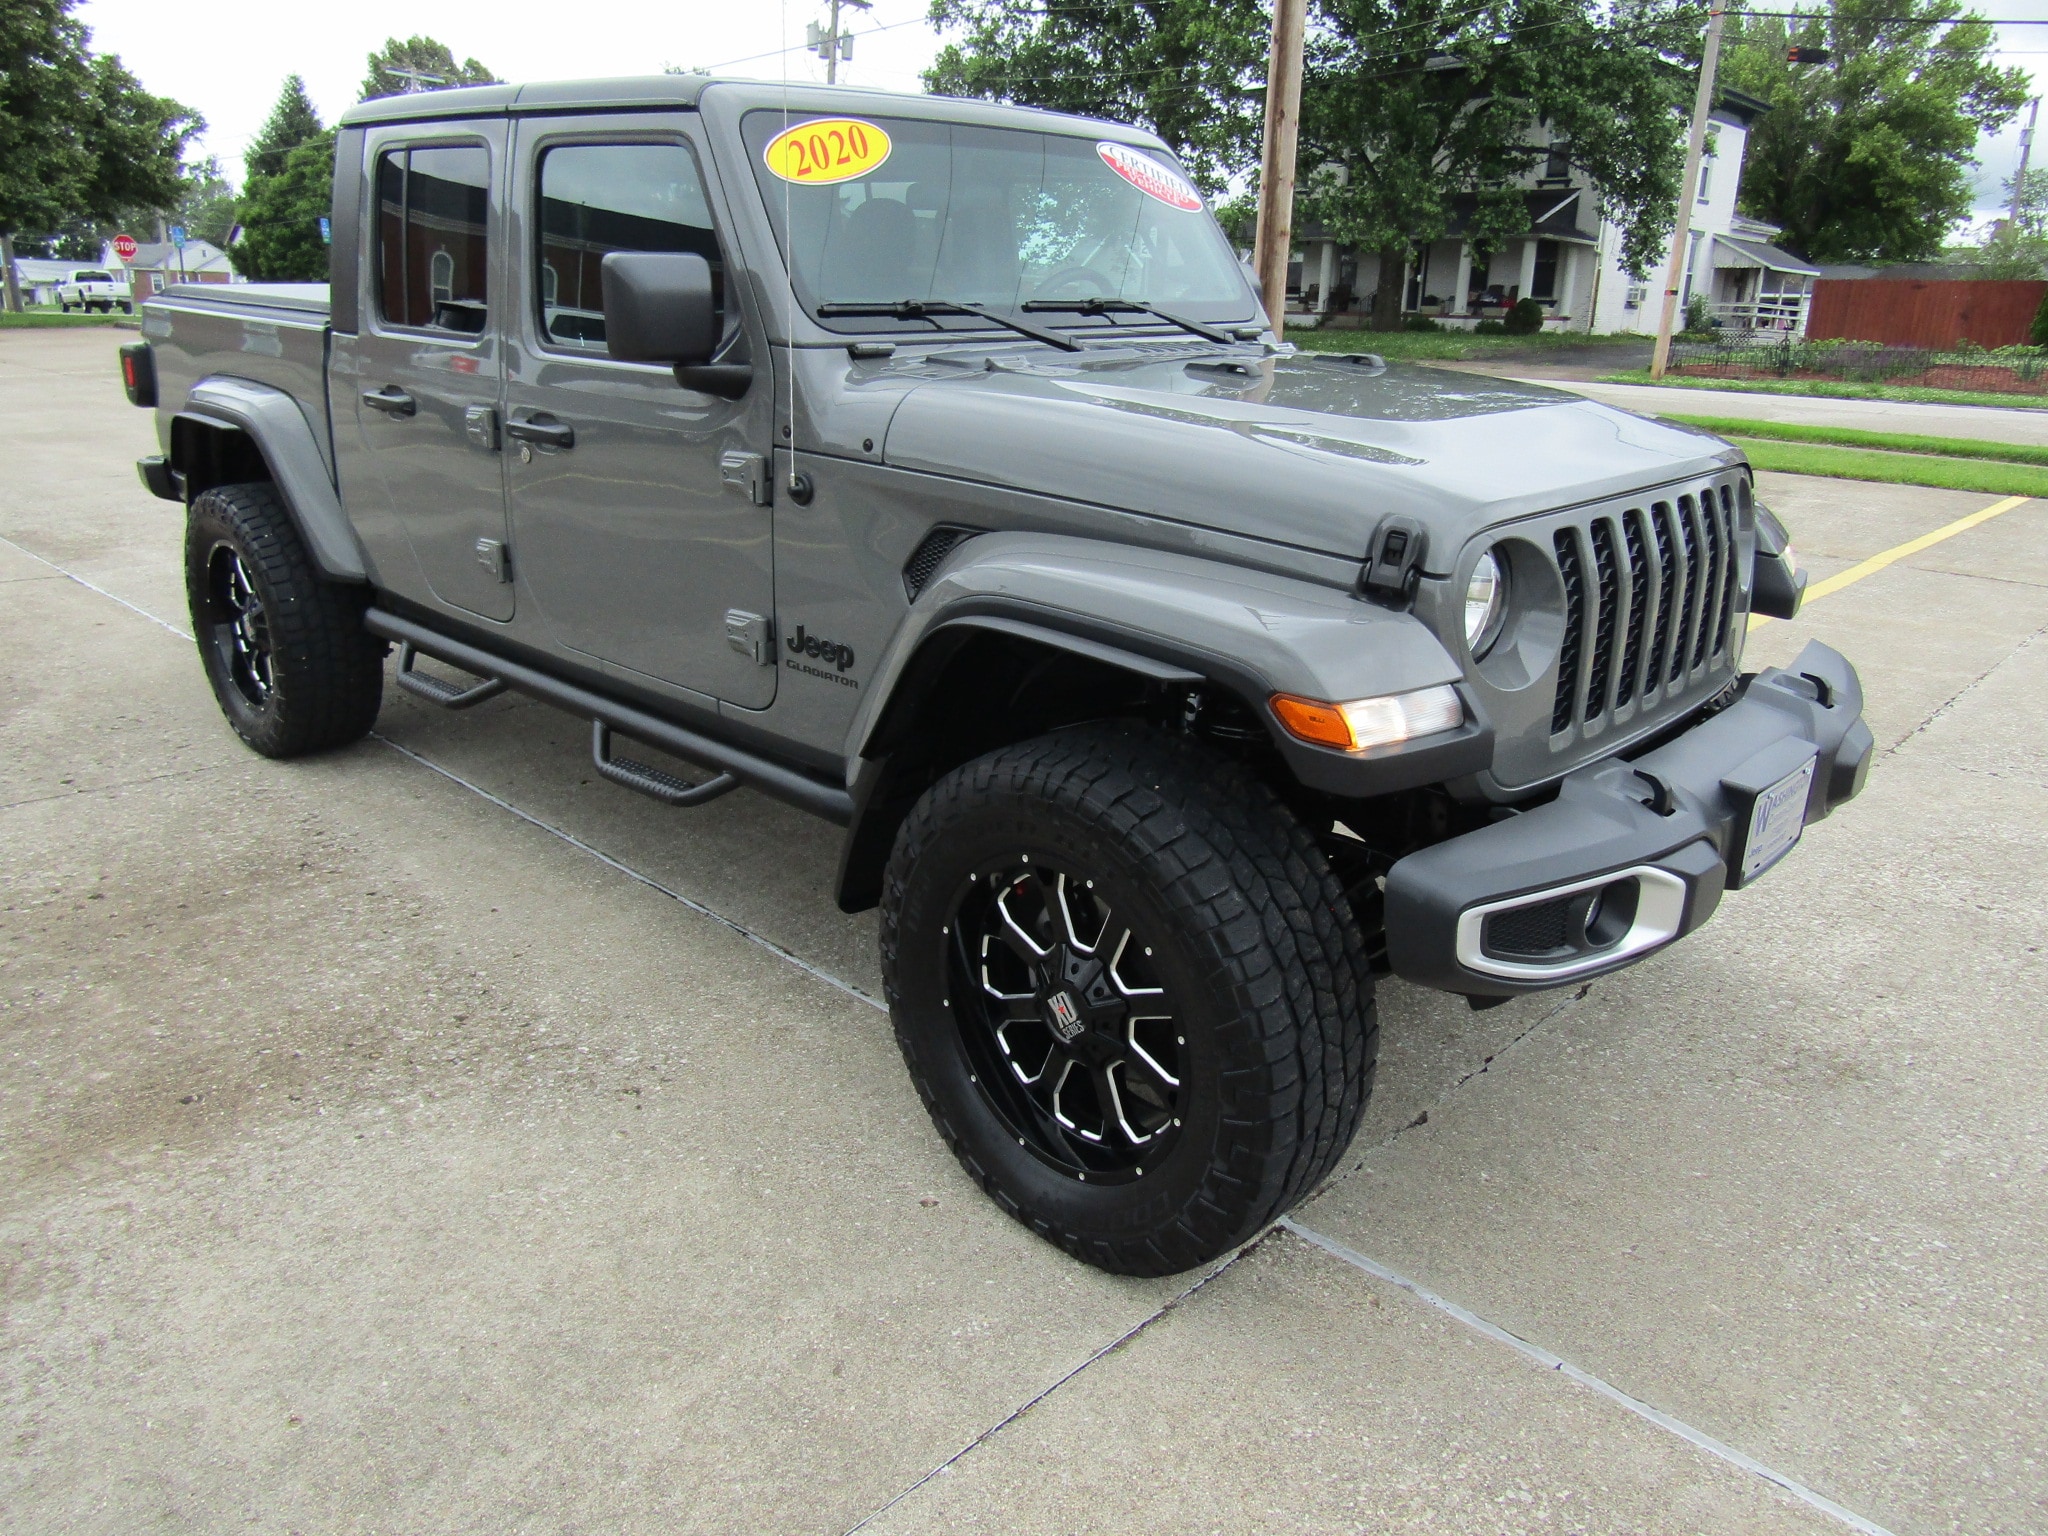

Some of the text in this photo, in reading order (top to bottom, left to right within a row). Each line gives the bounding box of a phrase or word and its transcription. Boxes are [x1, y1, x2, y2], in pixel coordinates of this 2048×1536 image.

[788, 125, 868, 176] 2020
[1109, 147, 1190, 196] CERTIFIED
[114, 241, 136, 251] STOP
[787, 624, 854, 673] Jeep
[786, 659, 859, 690] GLADIATOR
[1062, 1020, 1085, 1040] SERIES
